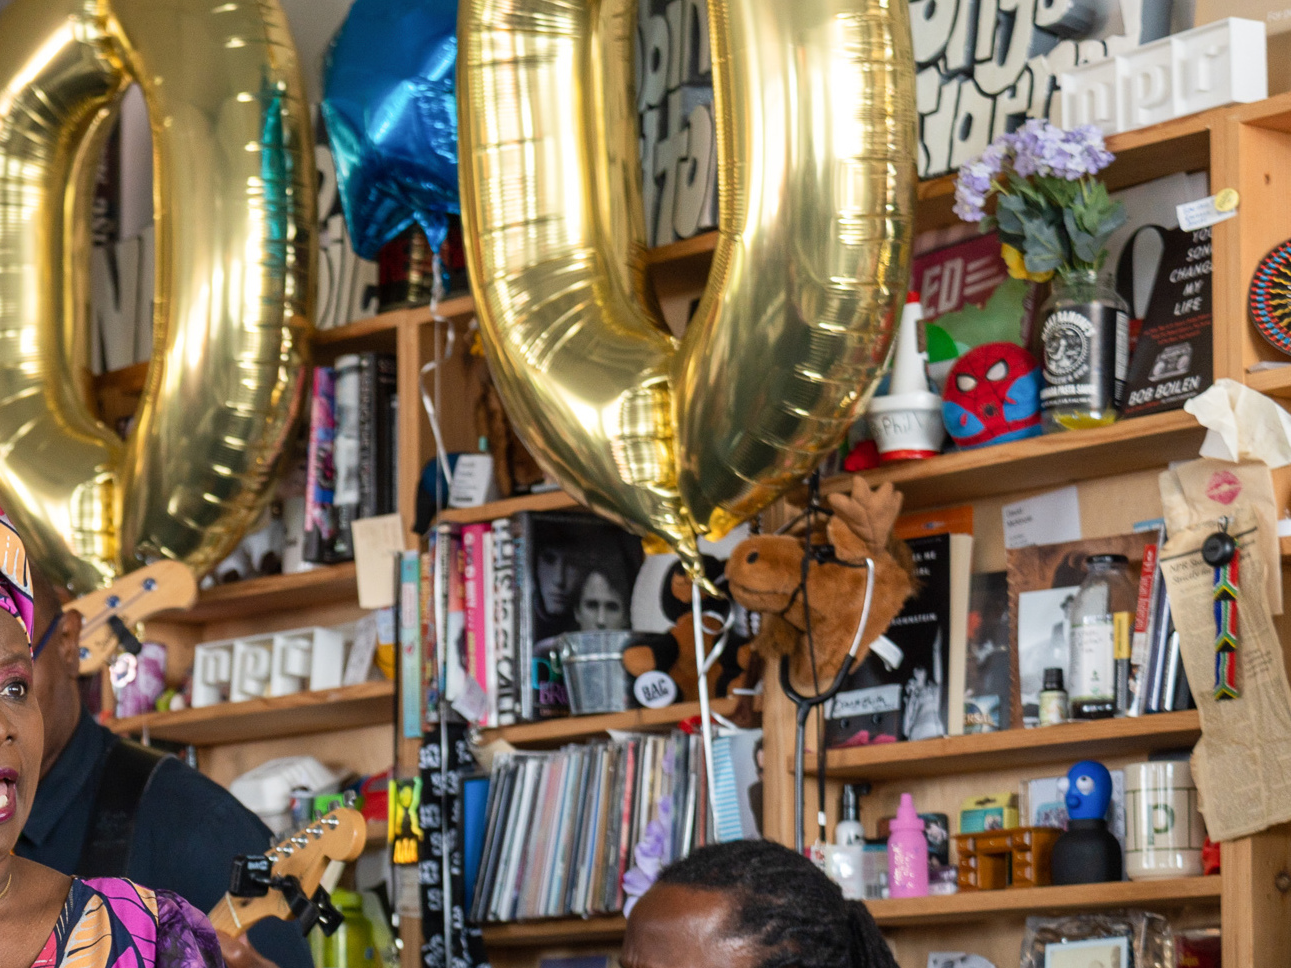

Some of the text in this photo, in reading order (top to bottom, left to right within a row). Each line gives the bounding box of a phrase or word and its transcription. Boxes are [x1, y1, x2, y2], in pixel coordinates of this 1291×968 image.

[1073, 44, 1231, 125] npr
[1186, 244, 1212, 262] SON
[1169, 260, 1213, 283] CHANG
[920, 256, 964, 317] ED
[1182, 280, 1204, 297] MY
[1174, 297, 1203, 316] LIFE
[1128, 385, 1154, 407] BOB
[1155, 374, 1201, 397] BOILEN
[203, 638, 312, 699] npr
